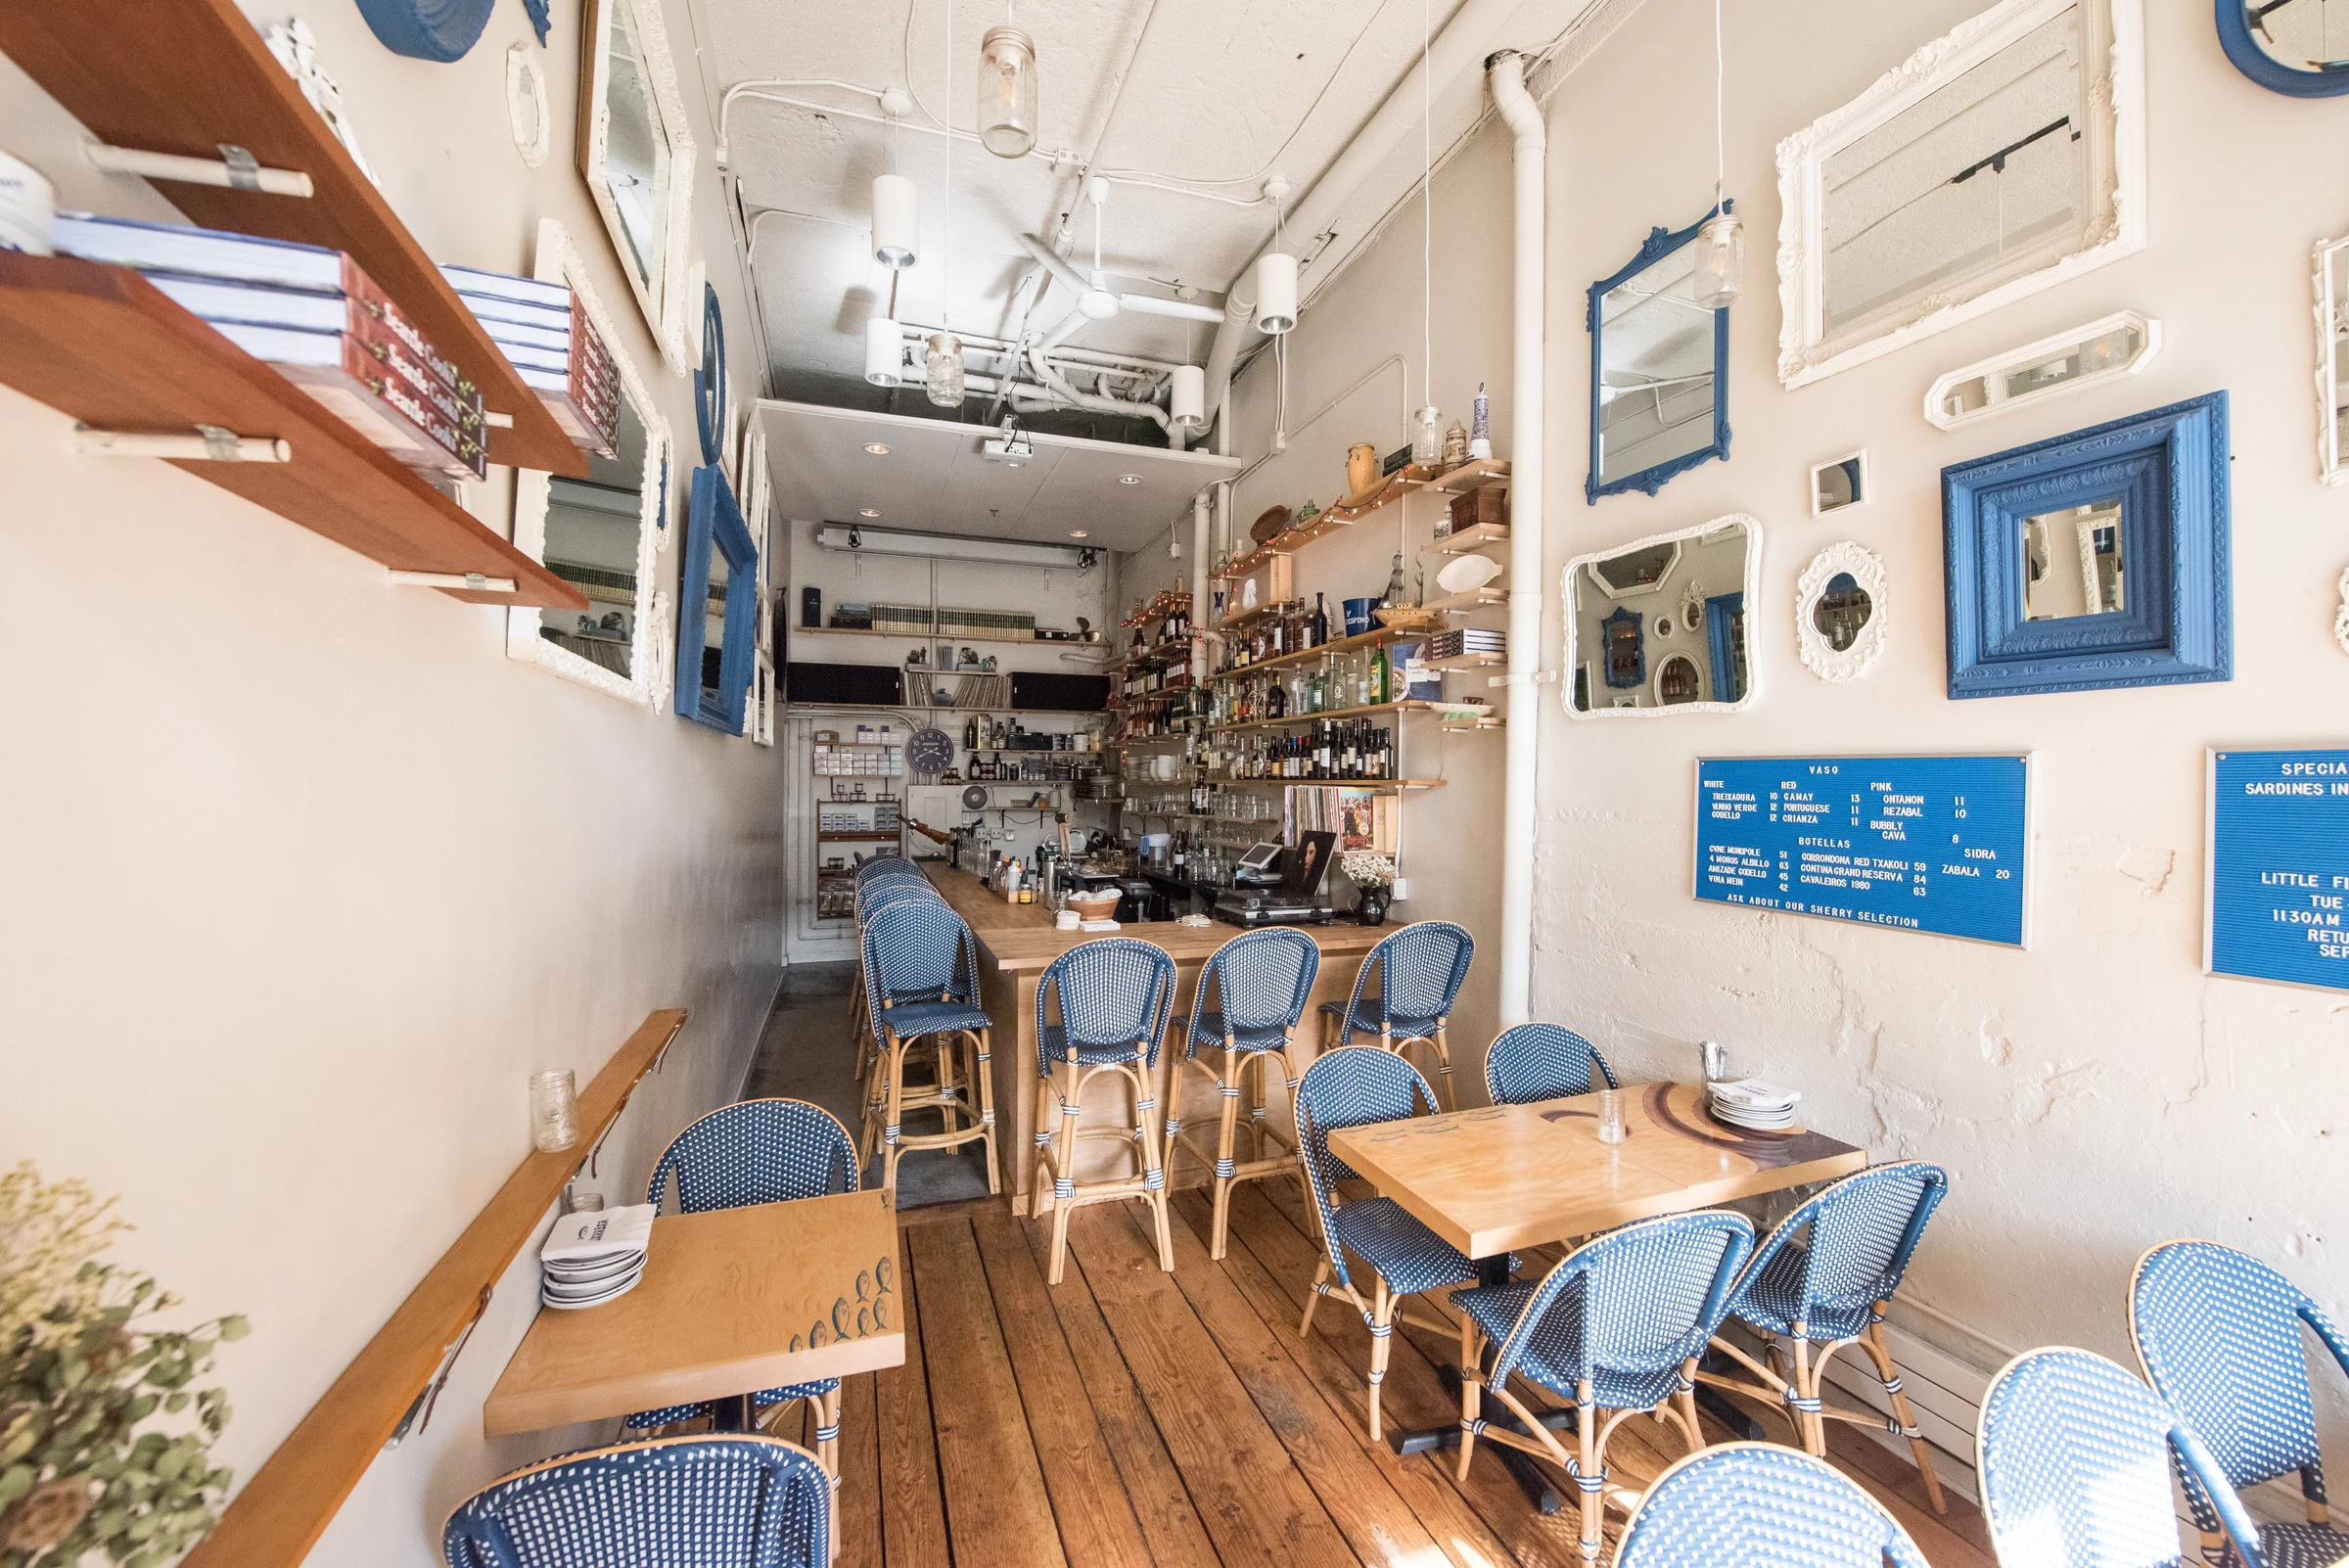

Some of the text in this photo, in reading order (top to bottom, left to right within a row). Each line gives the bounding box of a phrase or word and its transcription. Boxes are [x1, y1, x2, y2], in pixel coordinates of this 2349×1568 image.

[1809, 765, 1839, 775] VASO
[1703, 780, 1725, 789] WHITE
[1780, 780, 1797, 790] RED
[1868, 781, 1893, 792] PINK
[2244, 782, 2325, 797] SARDINES
[1712, 792, 1778, 802] TREIXADURA 10
[1783, 792, 1861, 804] GAMAY 13
[1882, 794, 1964, 807] ONTANON 11
[1711, 803, 1777, 812] VINHO VERDE 12
[1783, 803, 1860, 814] PORTUGUESE 11
[1882, 806, 1967, 819] REZABAL 10
[1769, 813, 1777, 822] 12
[1781, 813, 1859, 826] CRIANZA 11
[1869, 819, 1904, 831] BUBBLY
[1798, 836, 1851, 849] BOTELLAS
[1881, 830, 1959, 844] CAVA 8
[1727, 846, 1761, 857] MONOPOLE
[1778, 851, 1787, 859] 51
[1963, 848, 1997, 860] SIDRA
[1709, 854, 1715, 863] 4
[1716, 854, 1739, 865] MONOS
[1740, 857, 1770, 868] ALBILLO
[1853, 856, 1870, 867] RED
[1871, 858, 1909, 871] TXAKOLI
[1913, 861, 1927, 872] 59
[1708, 864, 1736, 875] AMIZADE
[1778, 872, 1789, 882] 45
[1833, 866, 1862, 878] GRAND
[1862, 868, 1904, 883] RESERVA
[1912, 874, 1927, 885] 84
[1941, 863, 2010, 880] ZABALA 20
[1708, 874, 1789, 893] VINA MEIN 42
[1800, 874, 1927, 897] CAVALEIROS 1980 63
[2261, 871, 2320, 888] LITTLE
[2309, 894, 2344, 910] TUE
[1727, 893, 1918, 929] ASK ABOUT OUR SHERRY SELECTION
